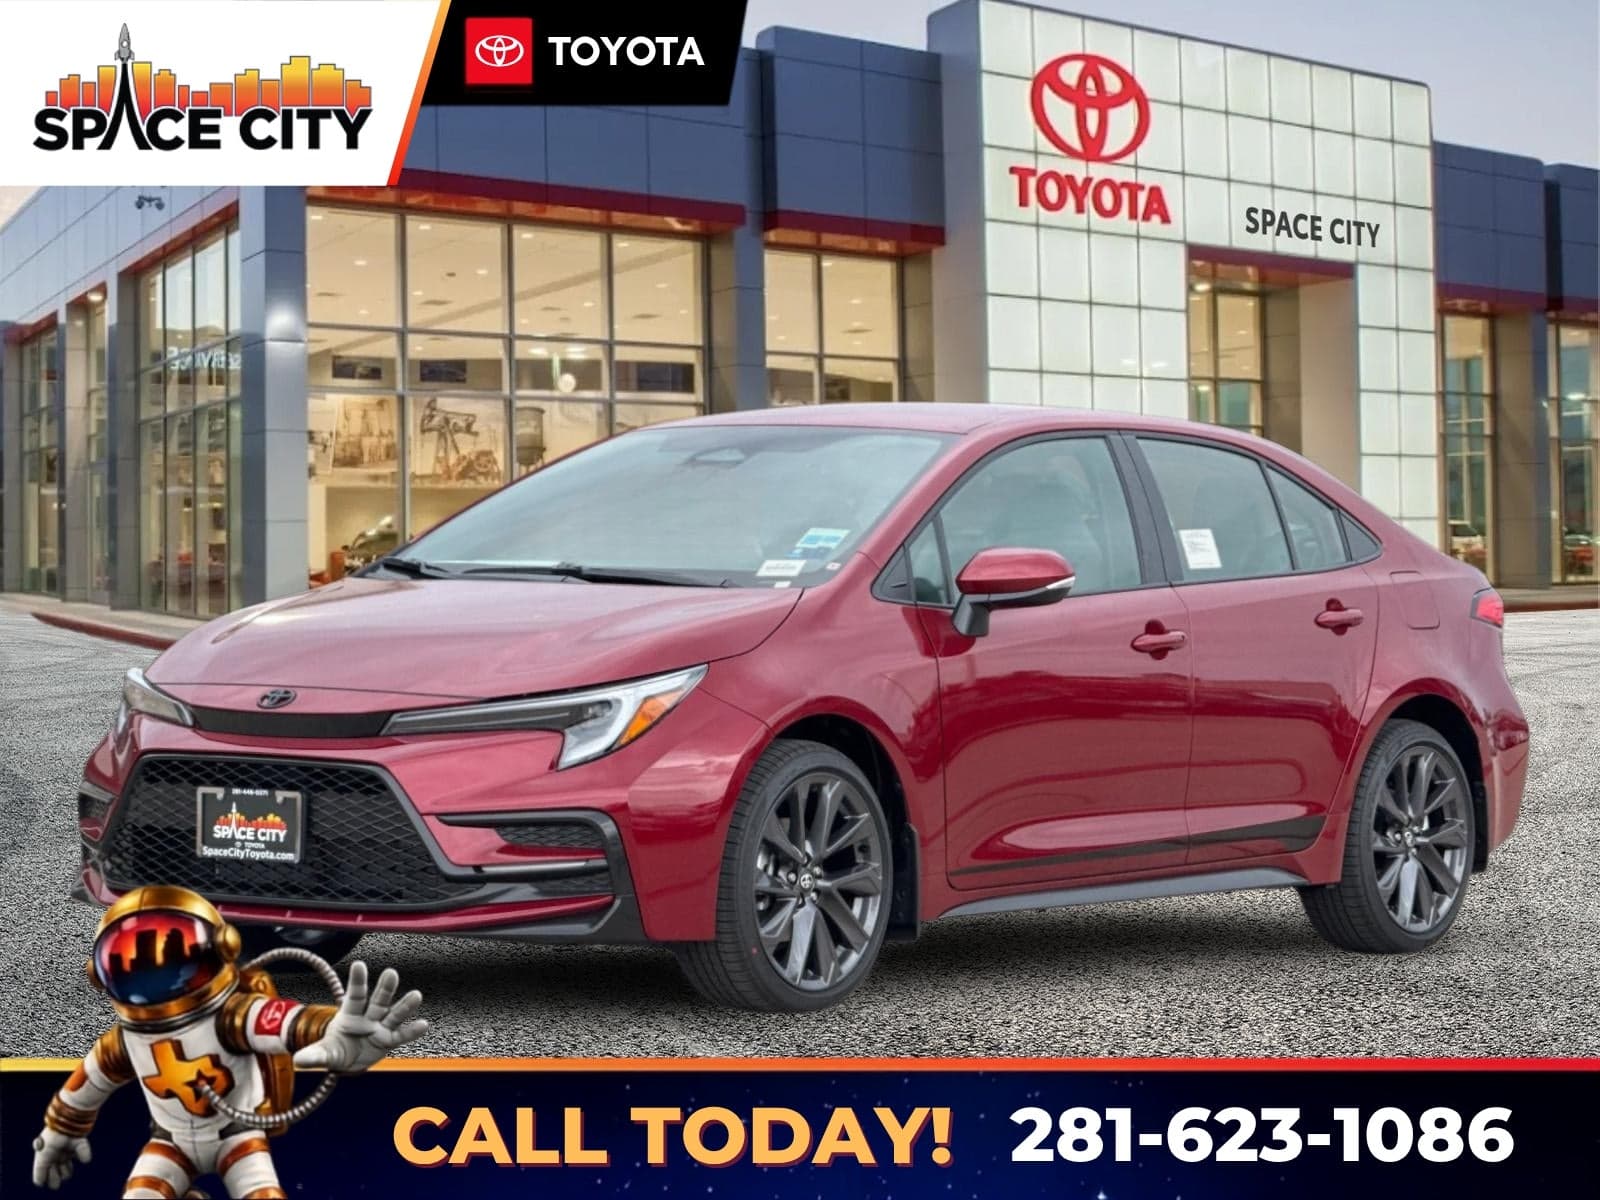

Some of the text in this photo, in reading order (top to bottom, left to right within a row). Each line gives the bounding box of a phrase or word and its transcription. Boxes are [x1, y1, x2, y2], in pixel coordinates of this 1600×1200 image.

[1009, 166, 1172, 224] TOYOTA
[1245, 206, 1381, 248] SPACE CITY
[213, 824, 287, 842] SPACE CITY
[202, 846, 295, 860] SpaceCityToyota.com
